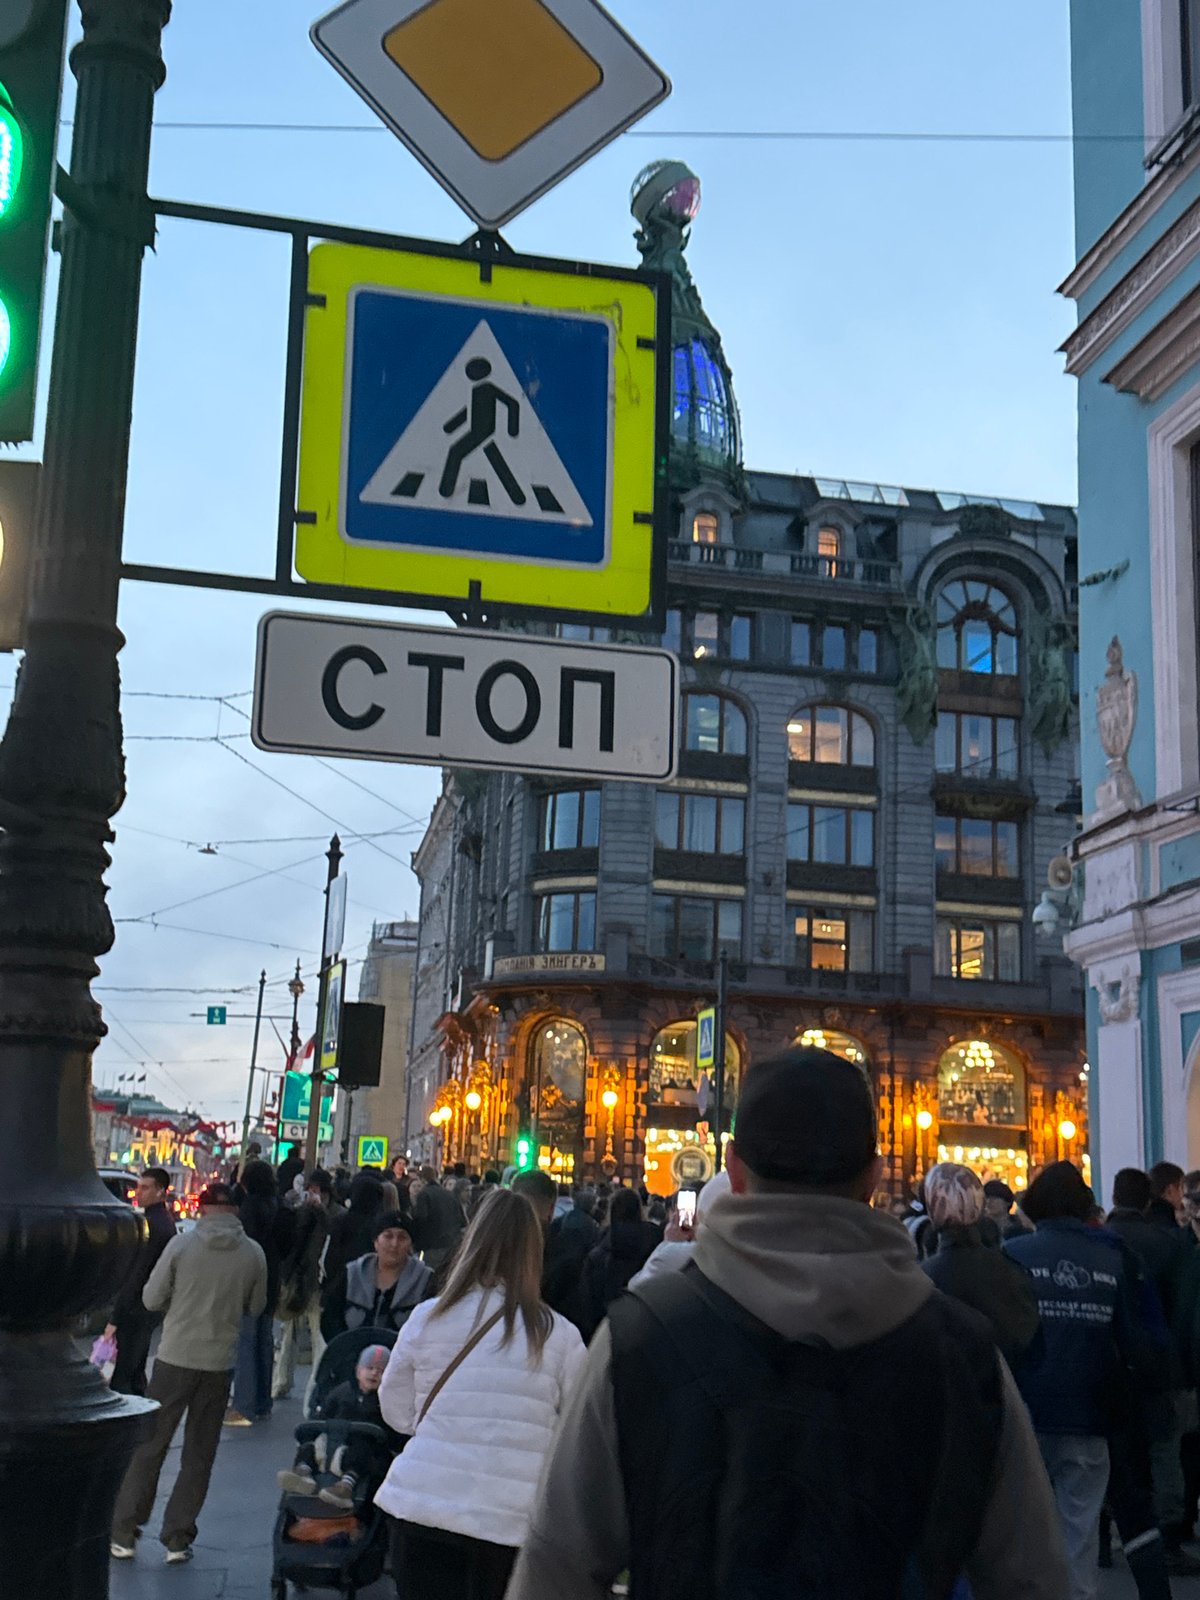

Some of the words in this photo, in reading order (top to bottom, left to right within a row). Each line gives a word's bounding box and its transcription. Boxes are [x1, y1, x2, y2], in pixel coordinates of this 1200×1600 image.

[321, 644, 615, 752] СТОП
[542, 955, 597, 969] ЗИНГЕРЪ
[291, 1126, 325, 1138] СТП
